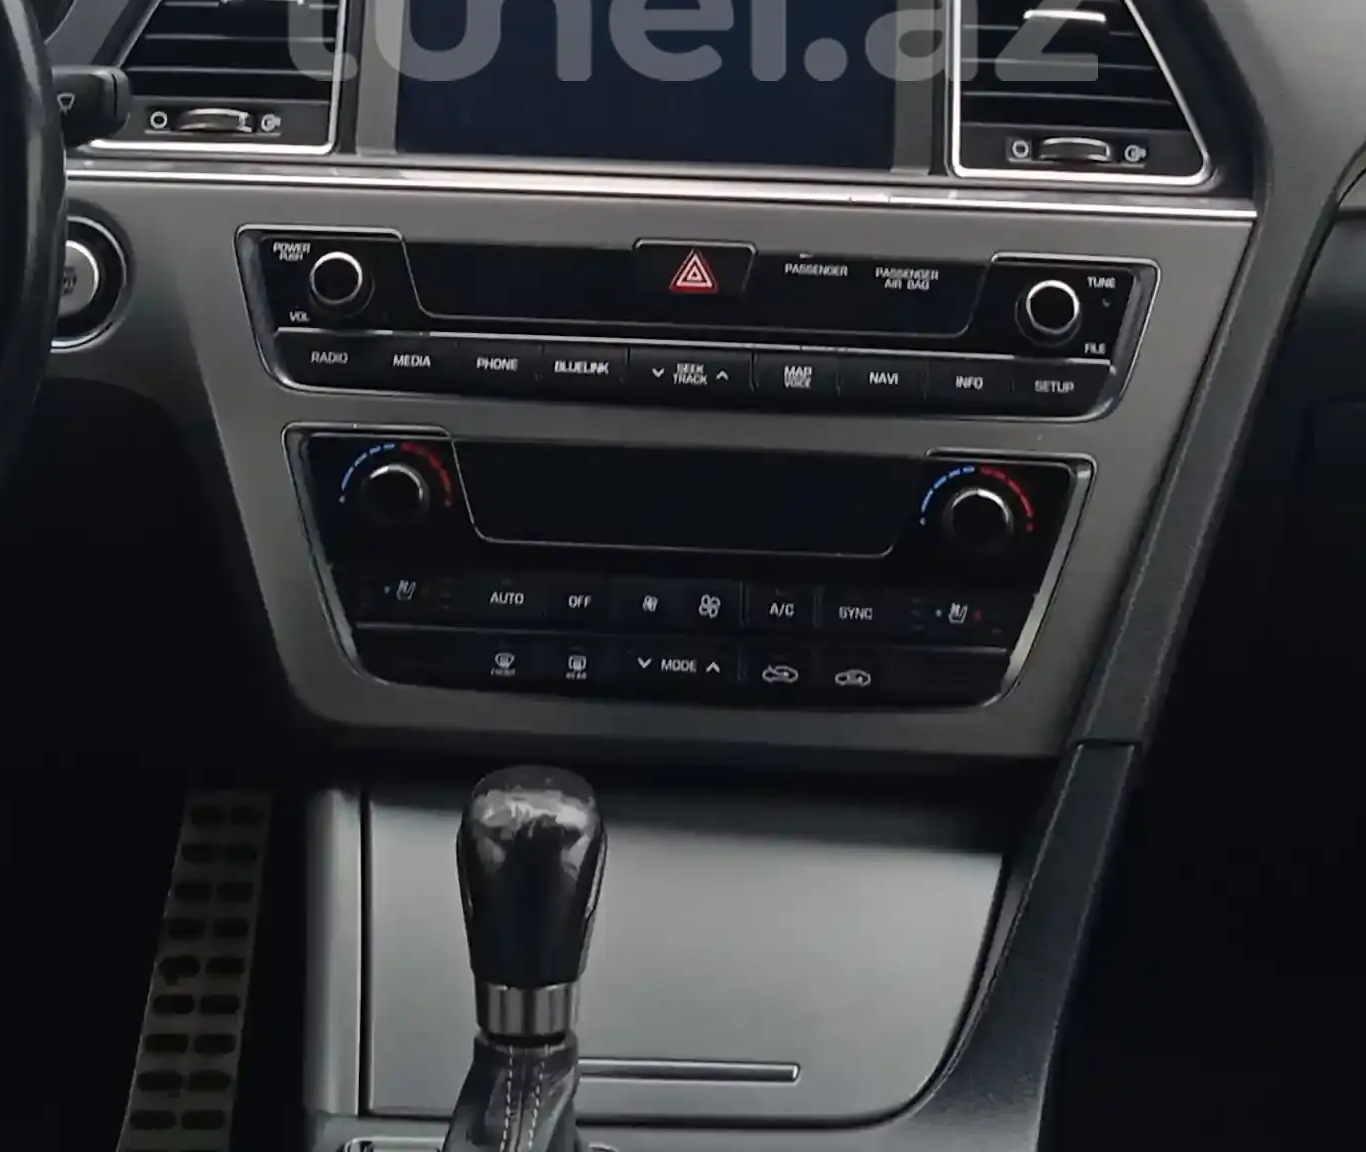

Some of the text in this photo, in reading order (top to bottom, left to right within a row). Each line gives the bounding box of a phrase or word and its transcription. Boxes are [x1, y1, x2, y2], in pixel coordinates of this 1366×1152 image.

[273, 242, 311, 254] POWER
[785, 263, 848, 277] PASSENGER
[875, 267, 939, 280] PASSENGER
[884, 278, 930, 291] AIR BAG
[1087, 276, 1116, 289] TUNE
[289, 311, 310, 323] VOL
[311, 351, 348, 364] RADIO
[393, 354, 431, 367] MEDIA
[476, 358, 519, 371] PHONE
[554, 361, 609, 375] BLUELINK
[784, 365, 813, 377] MAP
[673, 374, 708, 385] TRACK
[784, 376, 812, 388] VOICE
[869, 372, 899, 385] NAVI
[955, 375, 984, 389] INFO
[1035, 379, 1075, 393] SETUP
[490, 591, 524, 605] AUTO
[568, 594, 592, 608] OFF
[769, 602, 795, 617] A/C
[838, 606, 873, 621] SYNC
[661, 658, 697, 673] MODE
